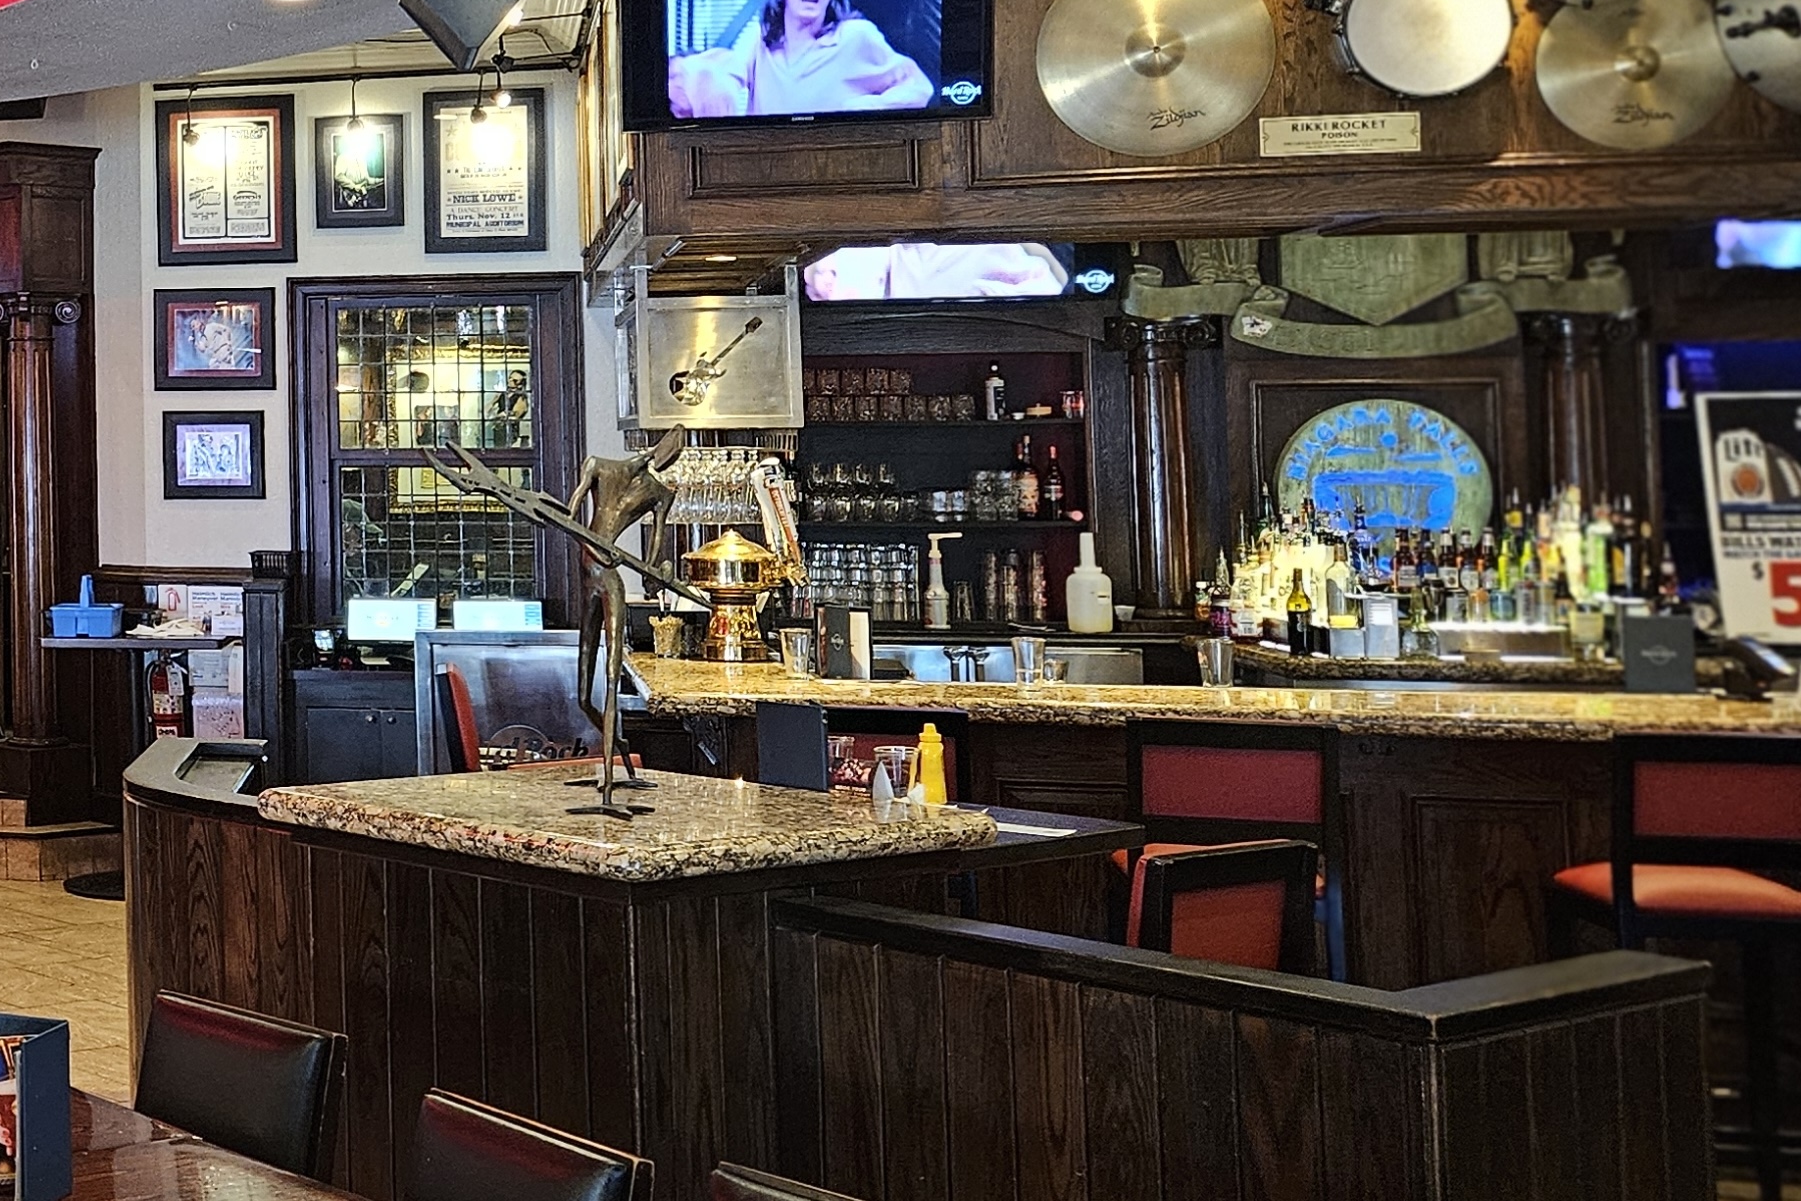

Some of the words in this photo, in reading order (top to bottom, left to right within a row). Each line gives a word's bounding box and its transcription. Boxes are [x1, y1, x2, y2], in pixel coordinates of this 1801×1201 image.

[1150, 106, 1206, 131] Zildjian
[1291, 122, 1328, 132] RIKKI
[1331, 119, 1387, 131] ROCKET
[1321, 132, 1358, 140] POISON
[452, 194, 480, 204] NICK
[482, 193, 516, 203] LOWE
[1286, 407, 1391, 481] NIAGARA
[1408, 408, 1479, 476] FALLS
